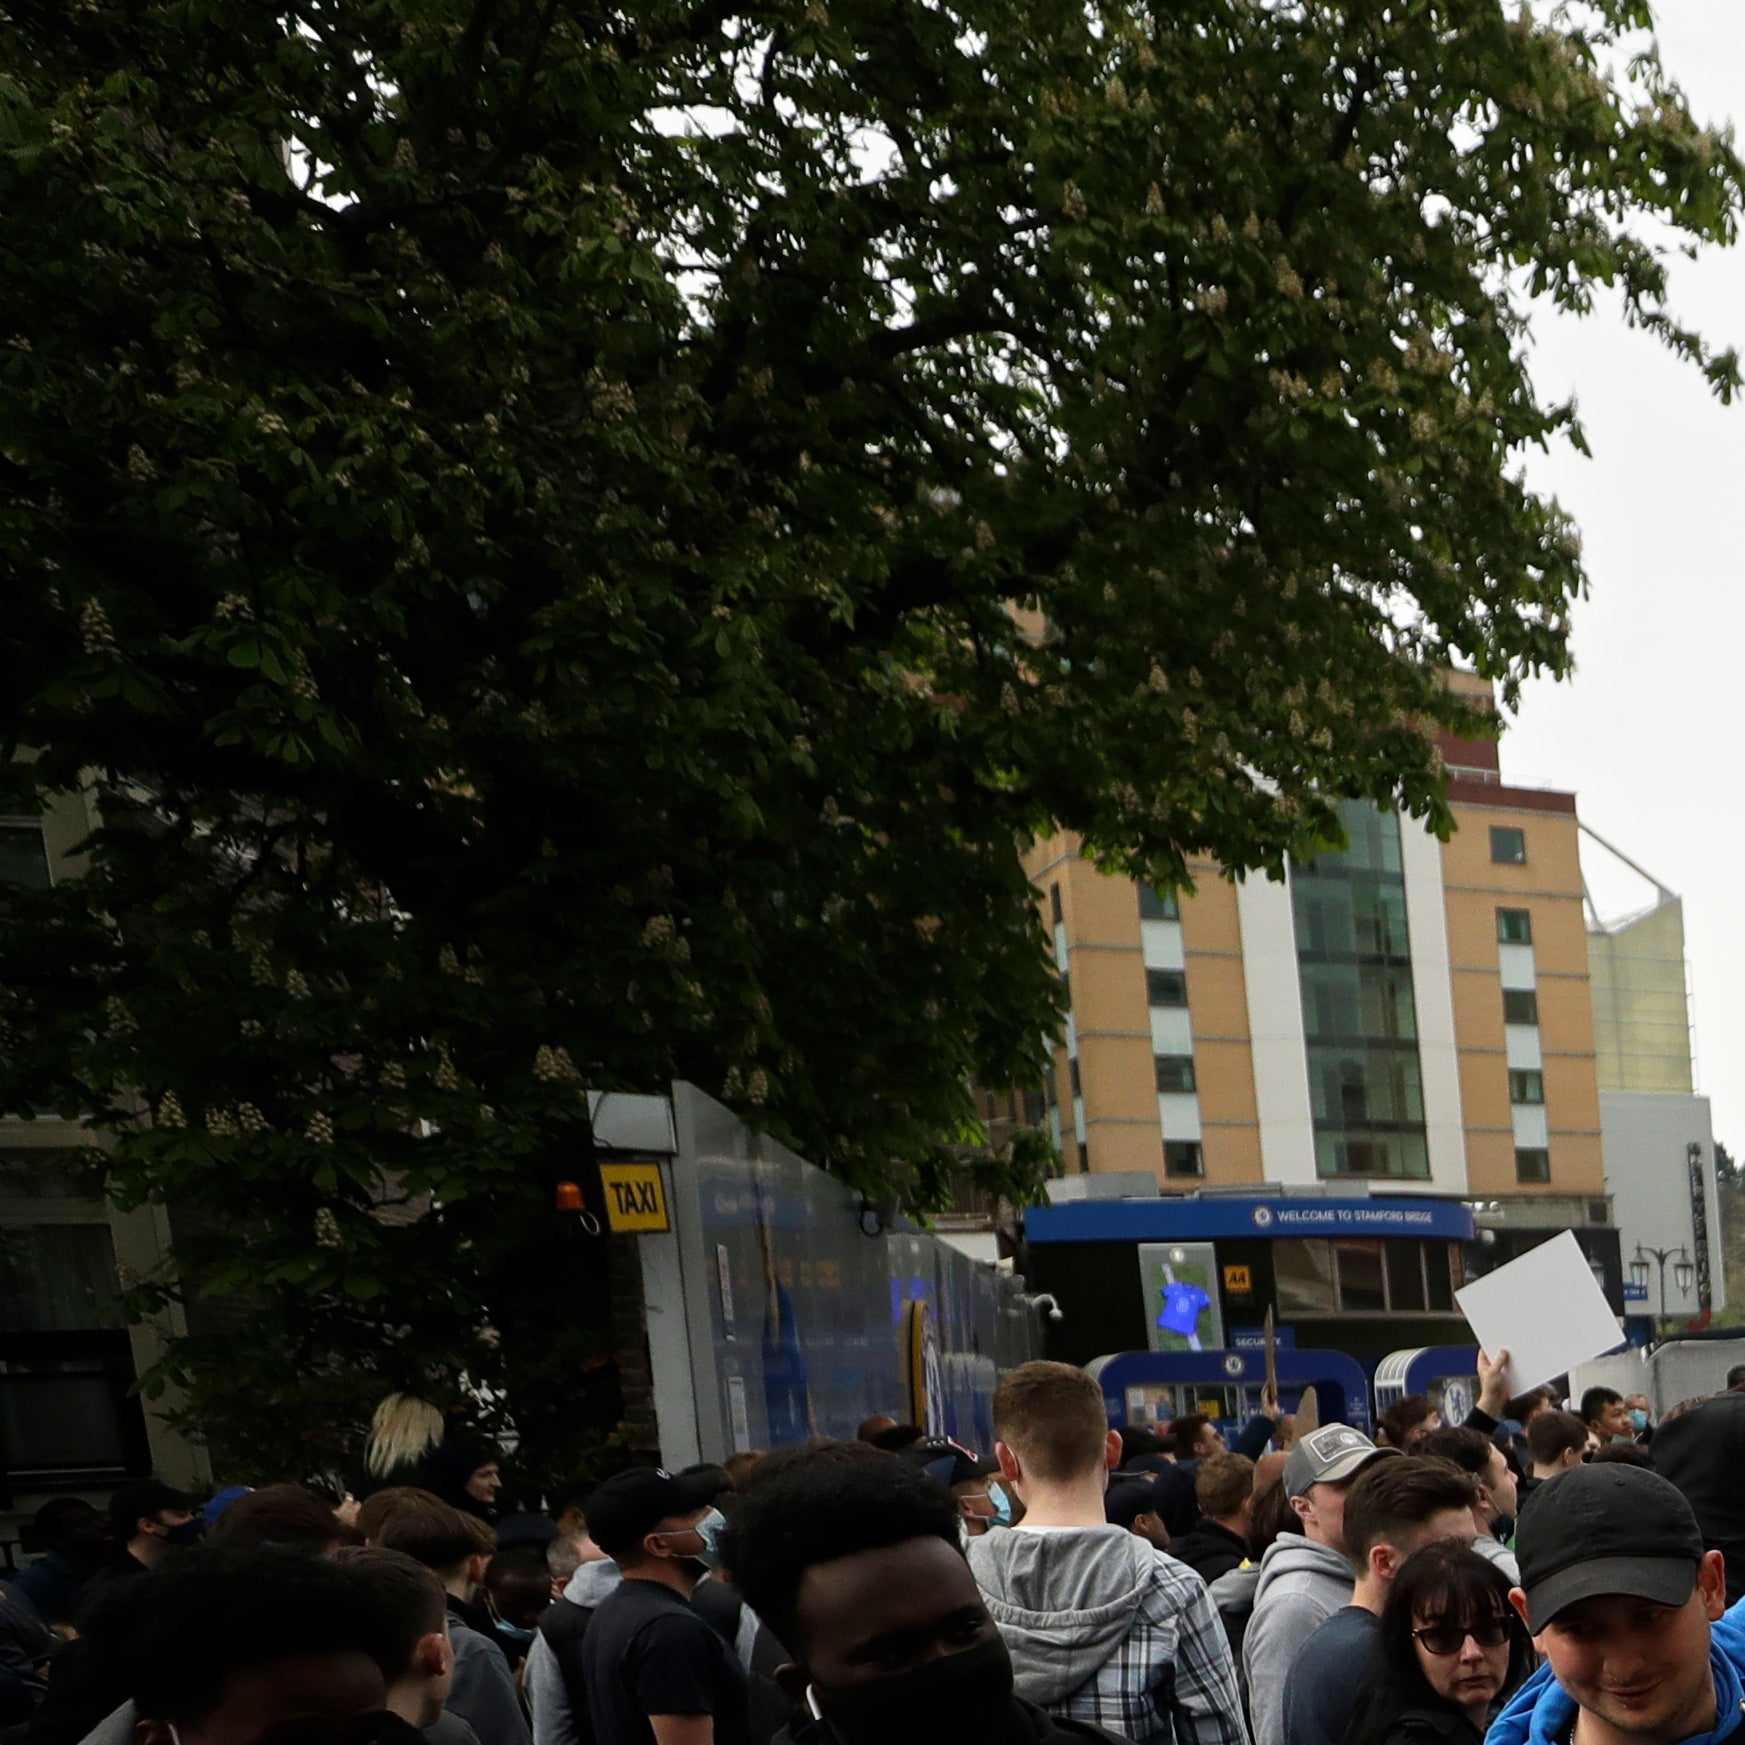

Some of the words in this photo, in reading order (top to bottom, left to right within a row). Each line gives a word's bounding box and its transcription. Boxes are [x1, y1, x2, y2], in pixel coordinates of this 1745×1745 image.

[610, 1182, 657, 1214] TAXI
[1277, 1210, 1335, 1223] WELCOME
[1337, 1210, 1351, 1221] TO
[1354, 1210, 1403, 1222] STAMFORD
[1404, 1210, 1433, 1223] BRIDGE
[1227, 1270, 1248, 1285] AA
[1235, 1337, 1282, 1348] SECURTY
